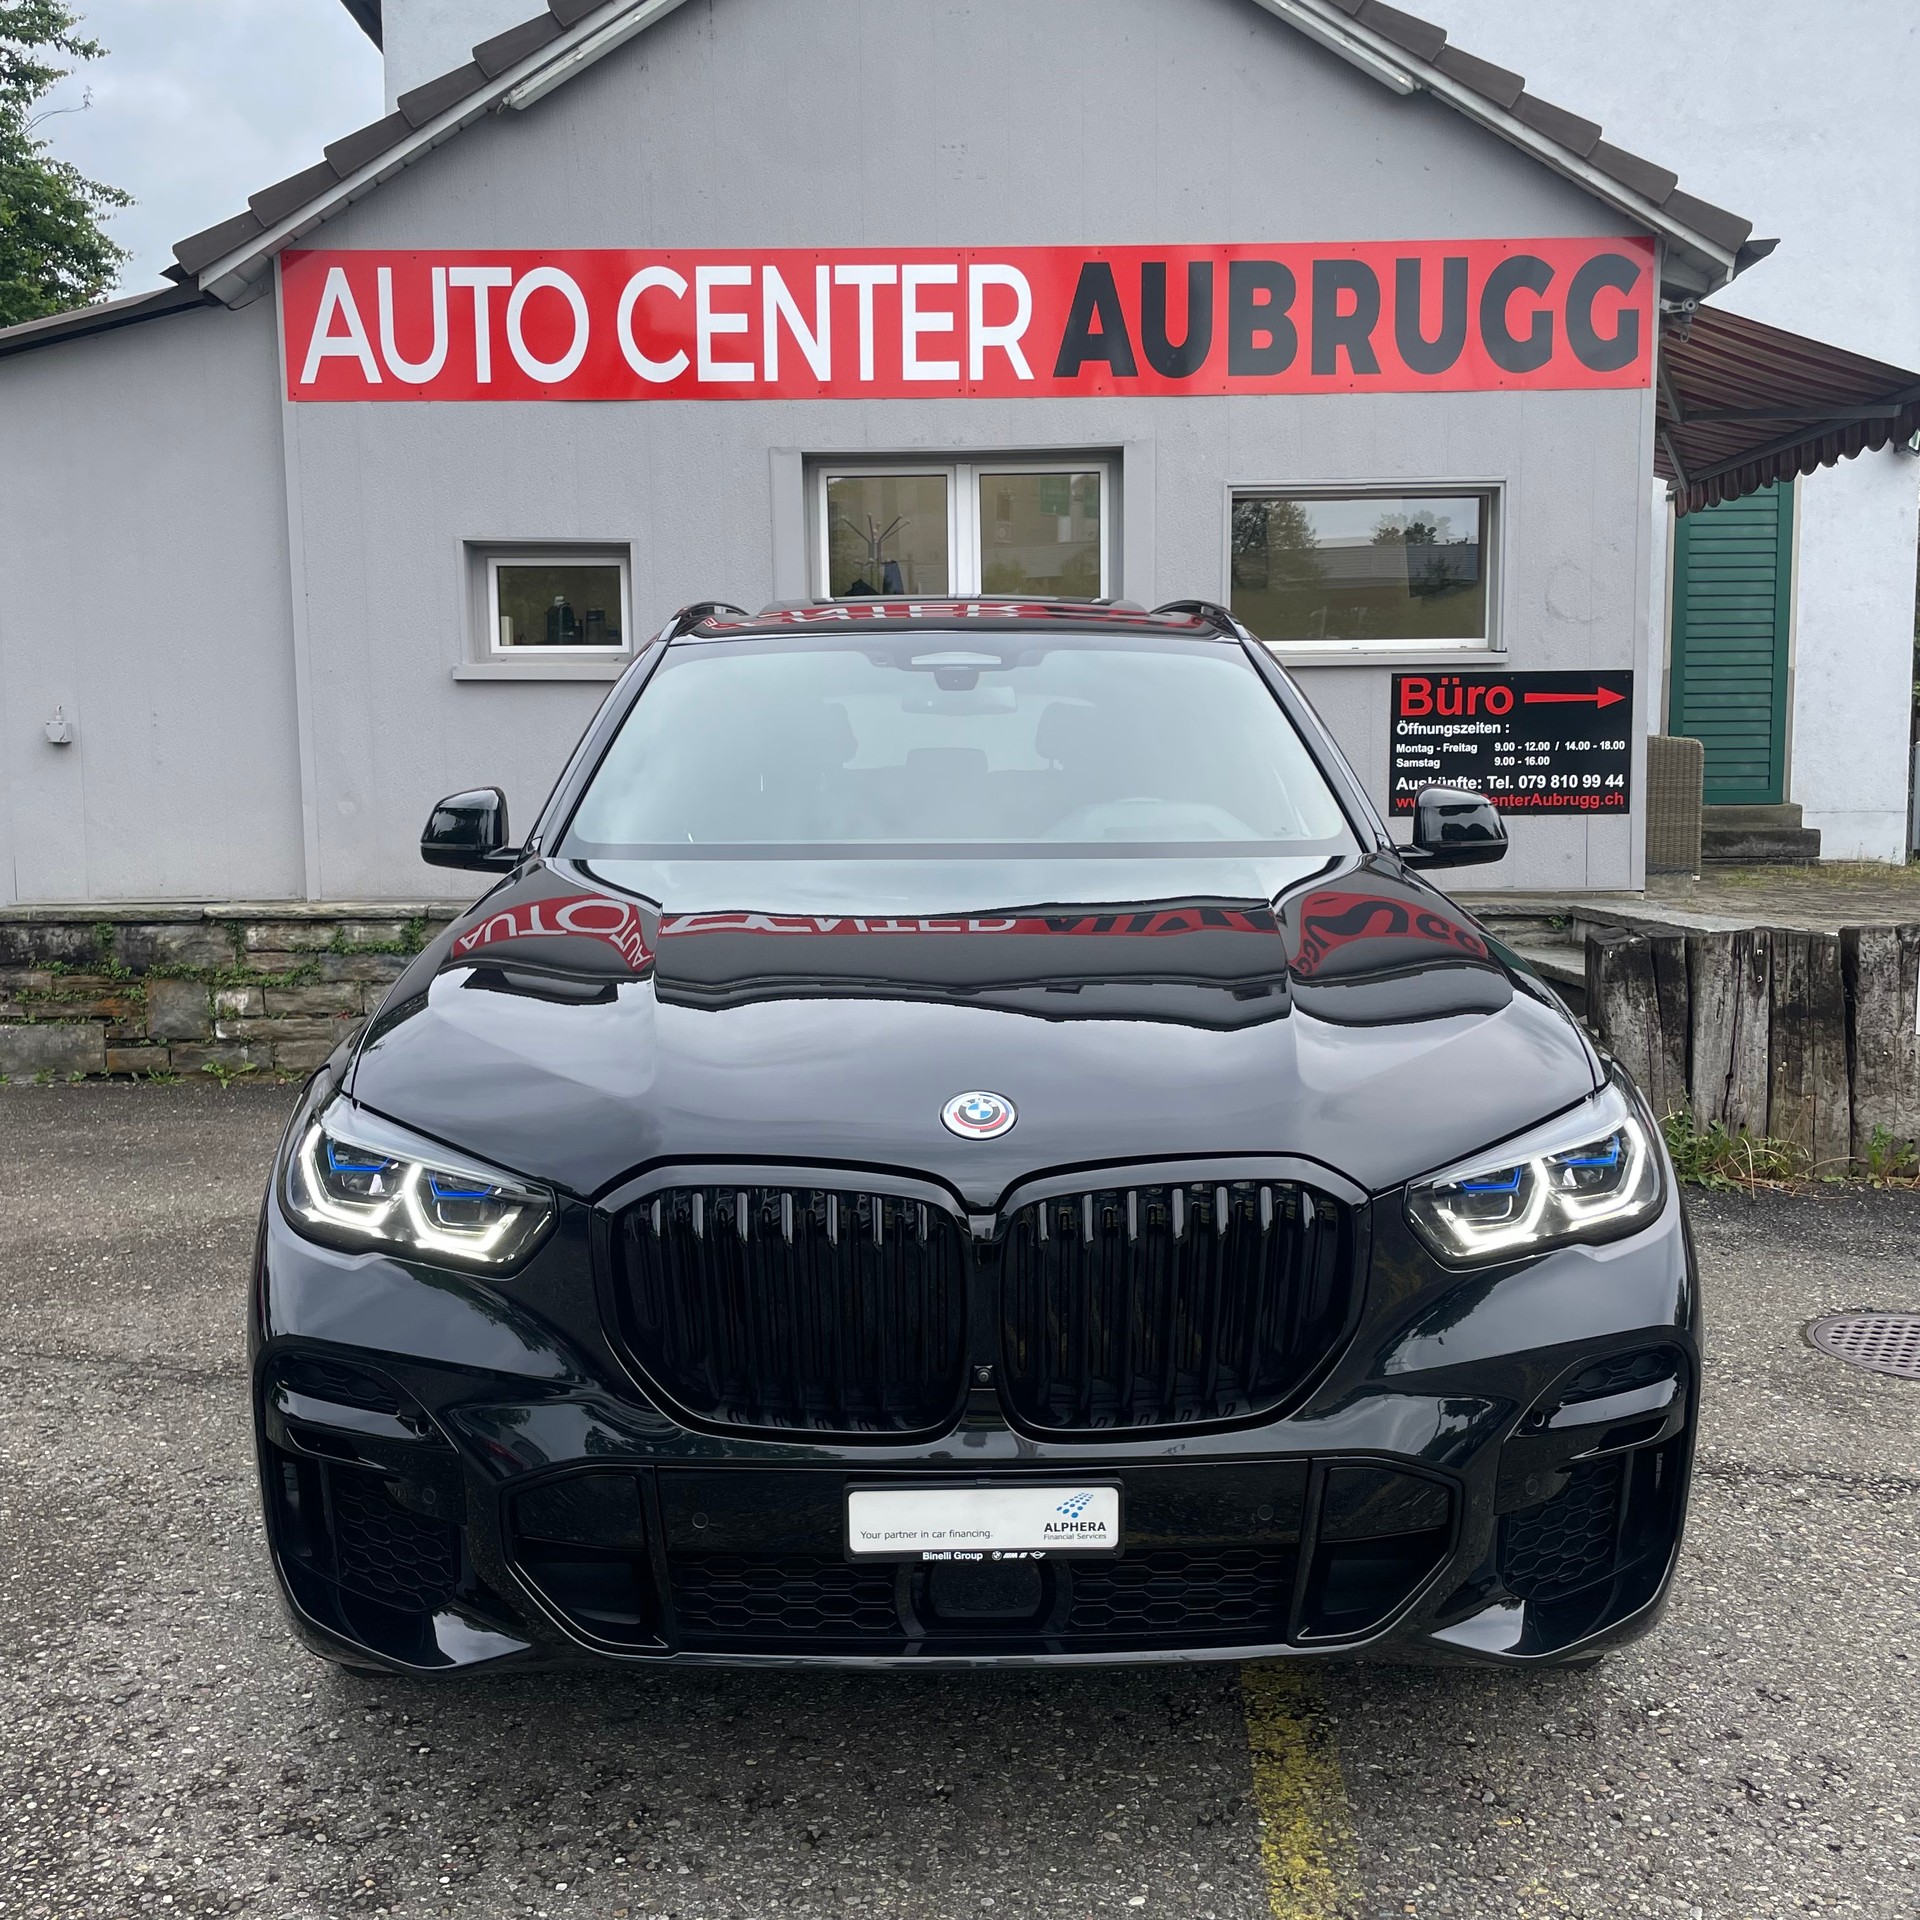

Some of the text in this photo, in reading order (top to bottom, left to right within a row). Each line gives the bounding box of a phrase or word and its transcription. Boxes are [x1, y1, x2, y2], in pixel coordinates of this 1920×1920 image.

[300, 254, 1642, 385] AUTO CENTER AUBRUGG
[1400, 677, 1515, 717] Büro
[1396, 720, 1501, 737] Öffnungszeiten
[1396, 743, 1434, 755] Montag
[1442, 743, 1478, 754] Freitag
[1494, 742, 1516, 752] 9.00
[1524, 741, 1551, 751] 12.00
[1565, 741, 1591, 751] 14.00
[1599, 740, 1626, 750] 18.00
[1396, 758, 1441, 769] Samstag
[1494, 756, 1516, 766] 9.00
[1524, 756, 1551, 766] 16.00
[1486, 775, 1514, 789] Tel.
[1518, 775, 1547, 789] 079
[1550, 774, 1579, 788] 810
[1582, 774, 1601, 788] 99
[1604, 773, 1625, 787] 44
[1044, 1521, 1107, 1532] ALPHERA
[860, 1529, 993, 1540] Your partner in car financing.
[922, 1551, 952, 1560] Binelli
[953, 1551, 984, 1561] Group
